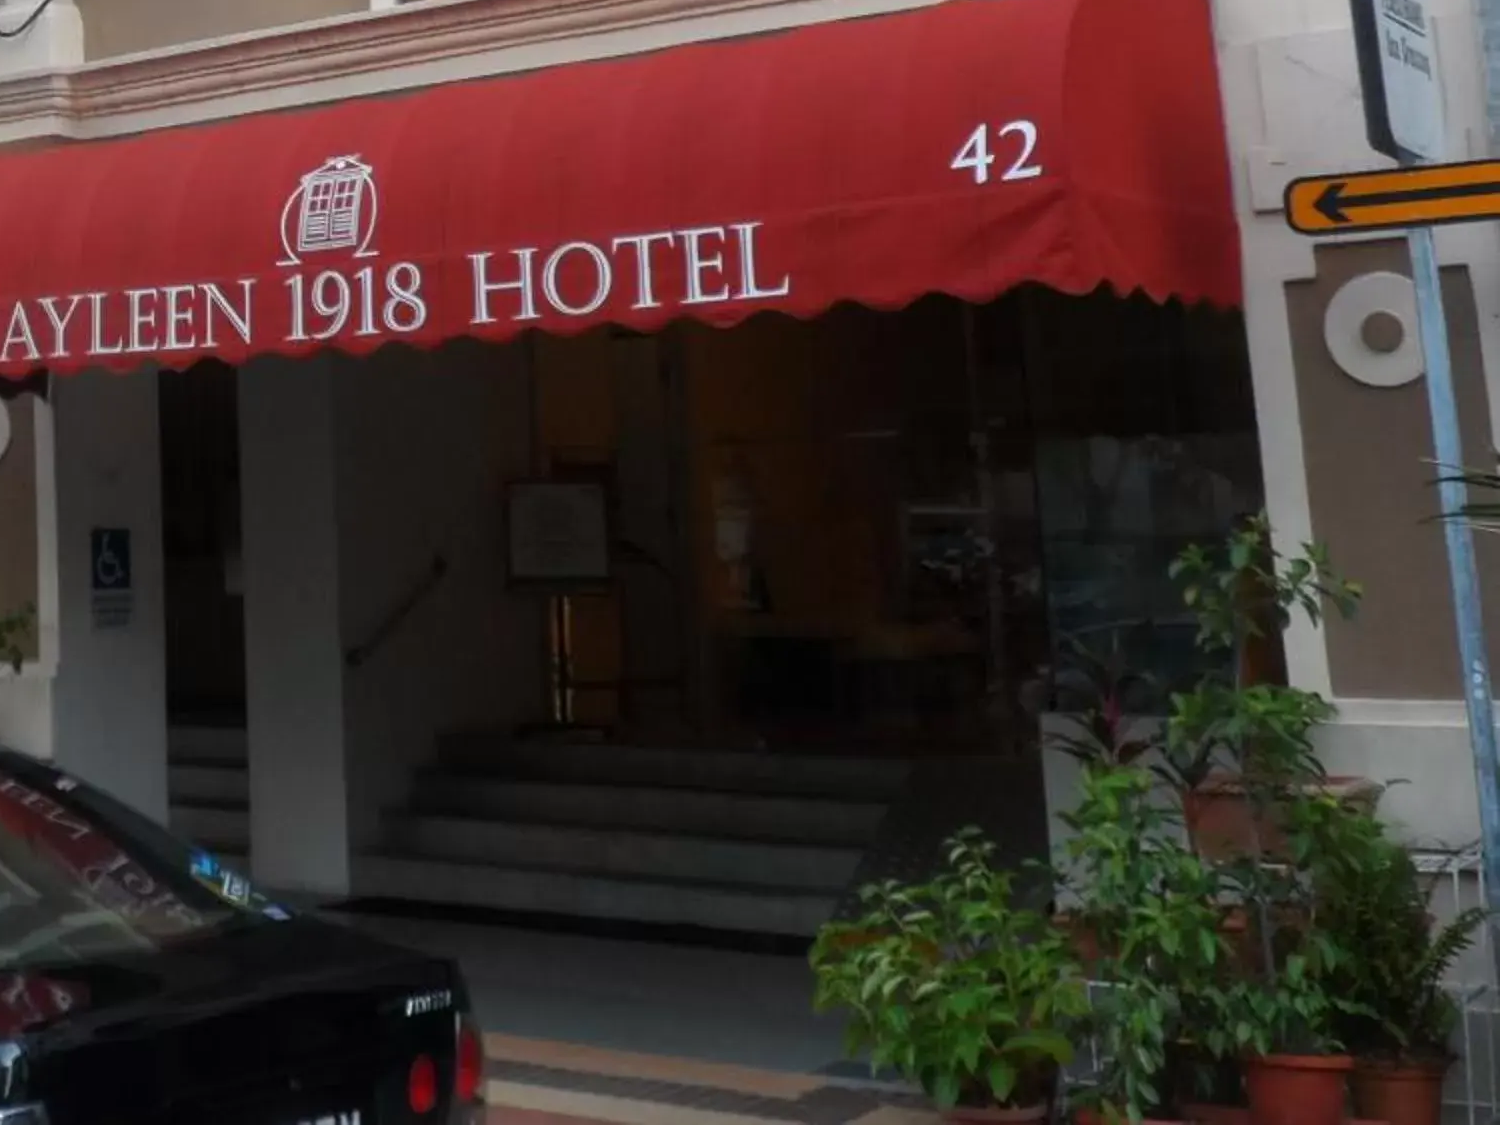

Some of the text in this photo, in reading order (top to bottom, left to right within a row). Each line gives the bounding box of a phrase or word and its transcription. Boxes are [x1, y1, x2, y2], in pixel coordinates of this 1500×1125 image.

[949, 119, 1045, 186] 42
[283, 261, 427, 342] 1918
[469, 221, 790, 325] HOTEL
